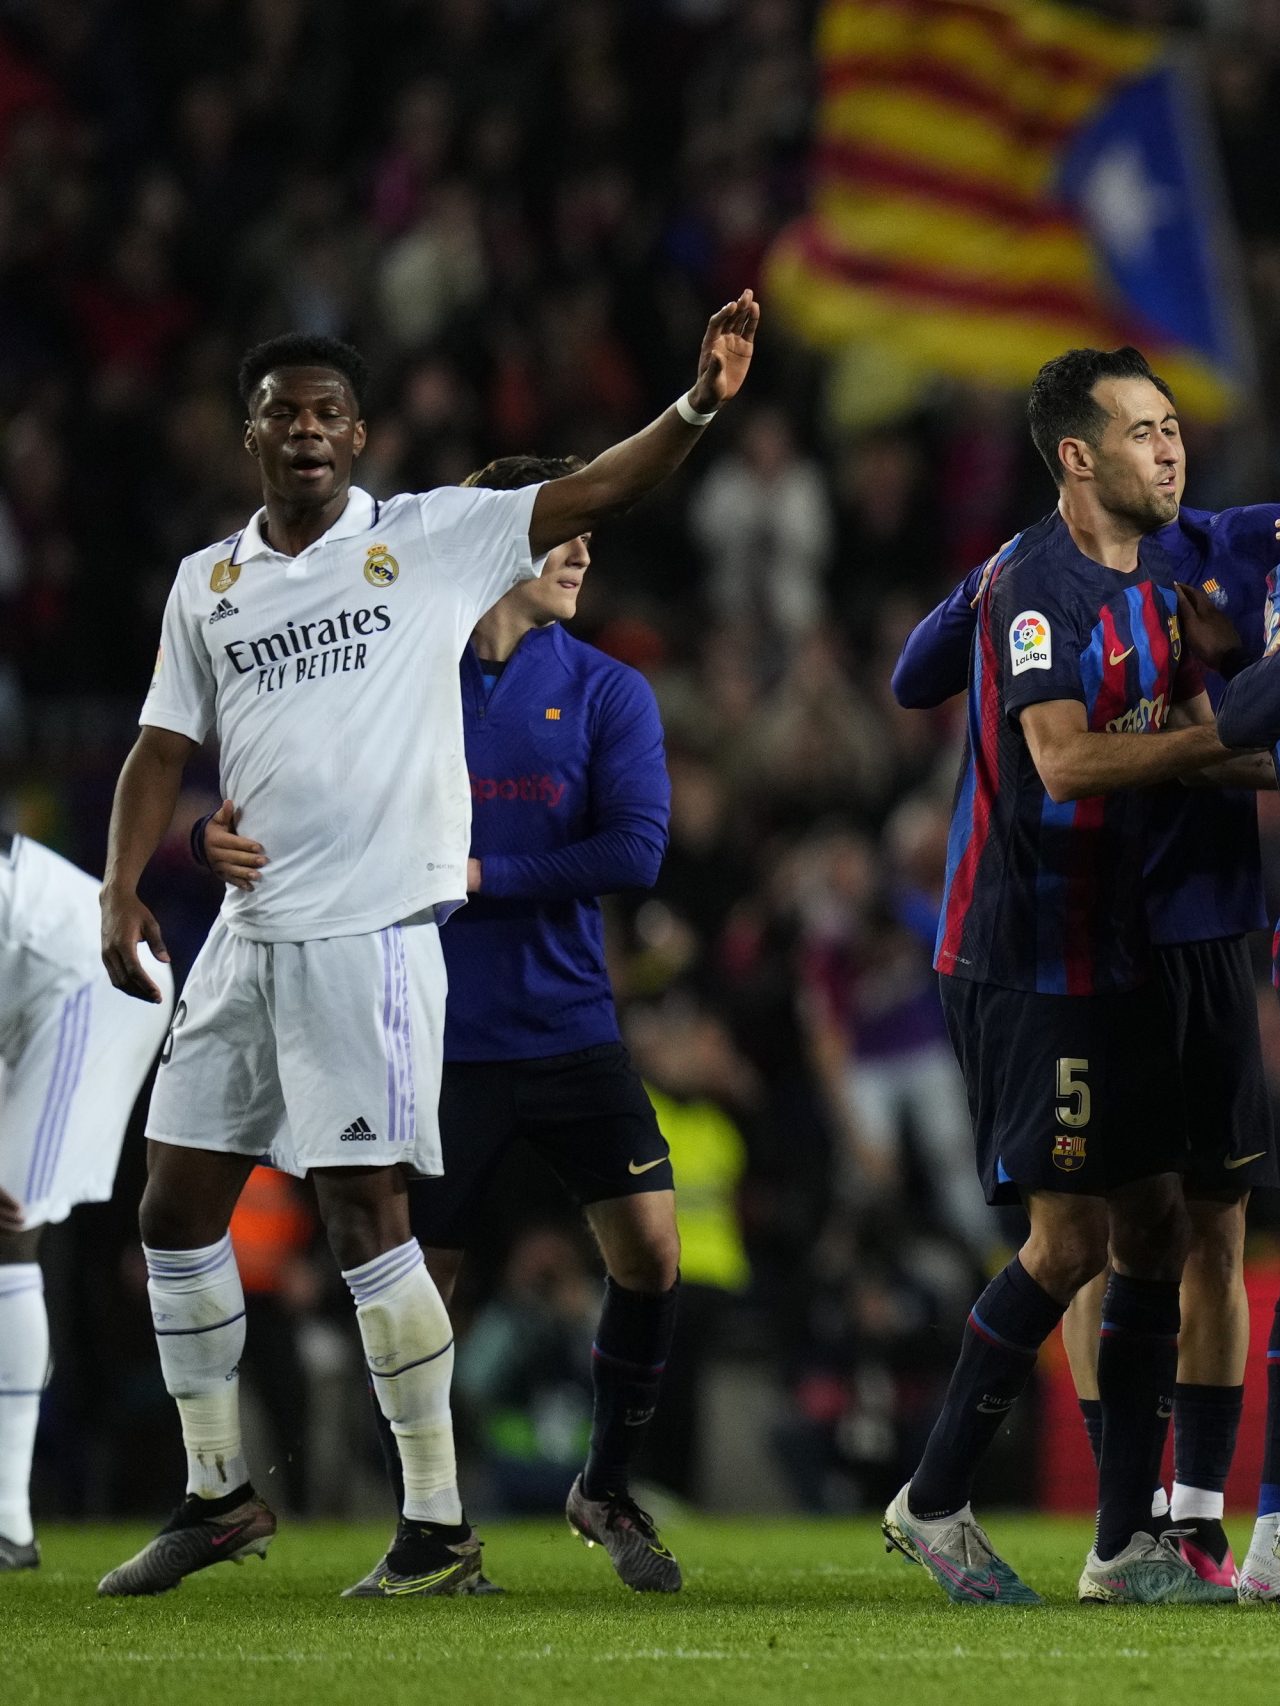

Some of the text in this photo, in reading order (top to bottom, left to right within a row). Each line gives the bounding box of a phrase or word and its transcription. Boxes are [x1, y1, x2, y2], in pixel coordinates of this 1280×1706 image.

[224, 605, 391, 675] Emirates
[1015, 651, 1047, 667] LaLiga
[257, 643, 367, 695] FLY BETTER
[1055, 1057, 1091, 1129] 5
[340, 1131, 377, 1142] adidas
